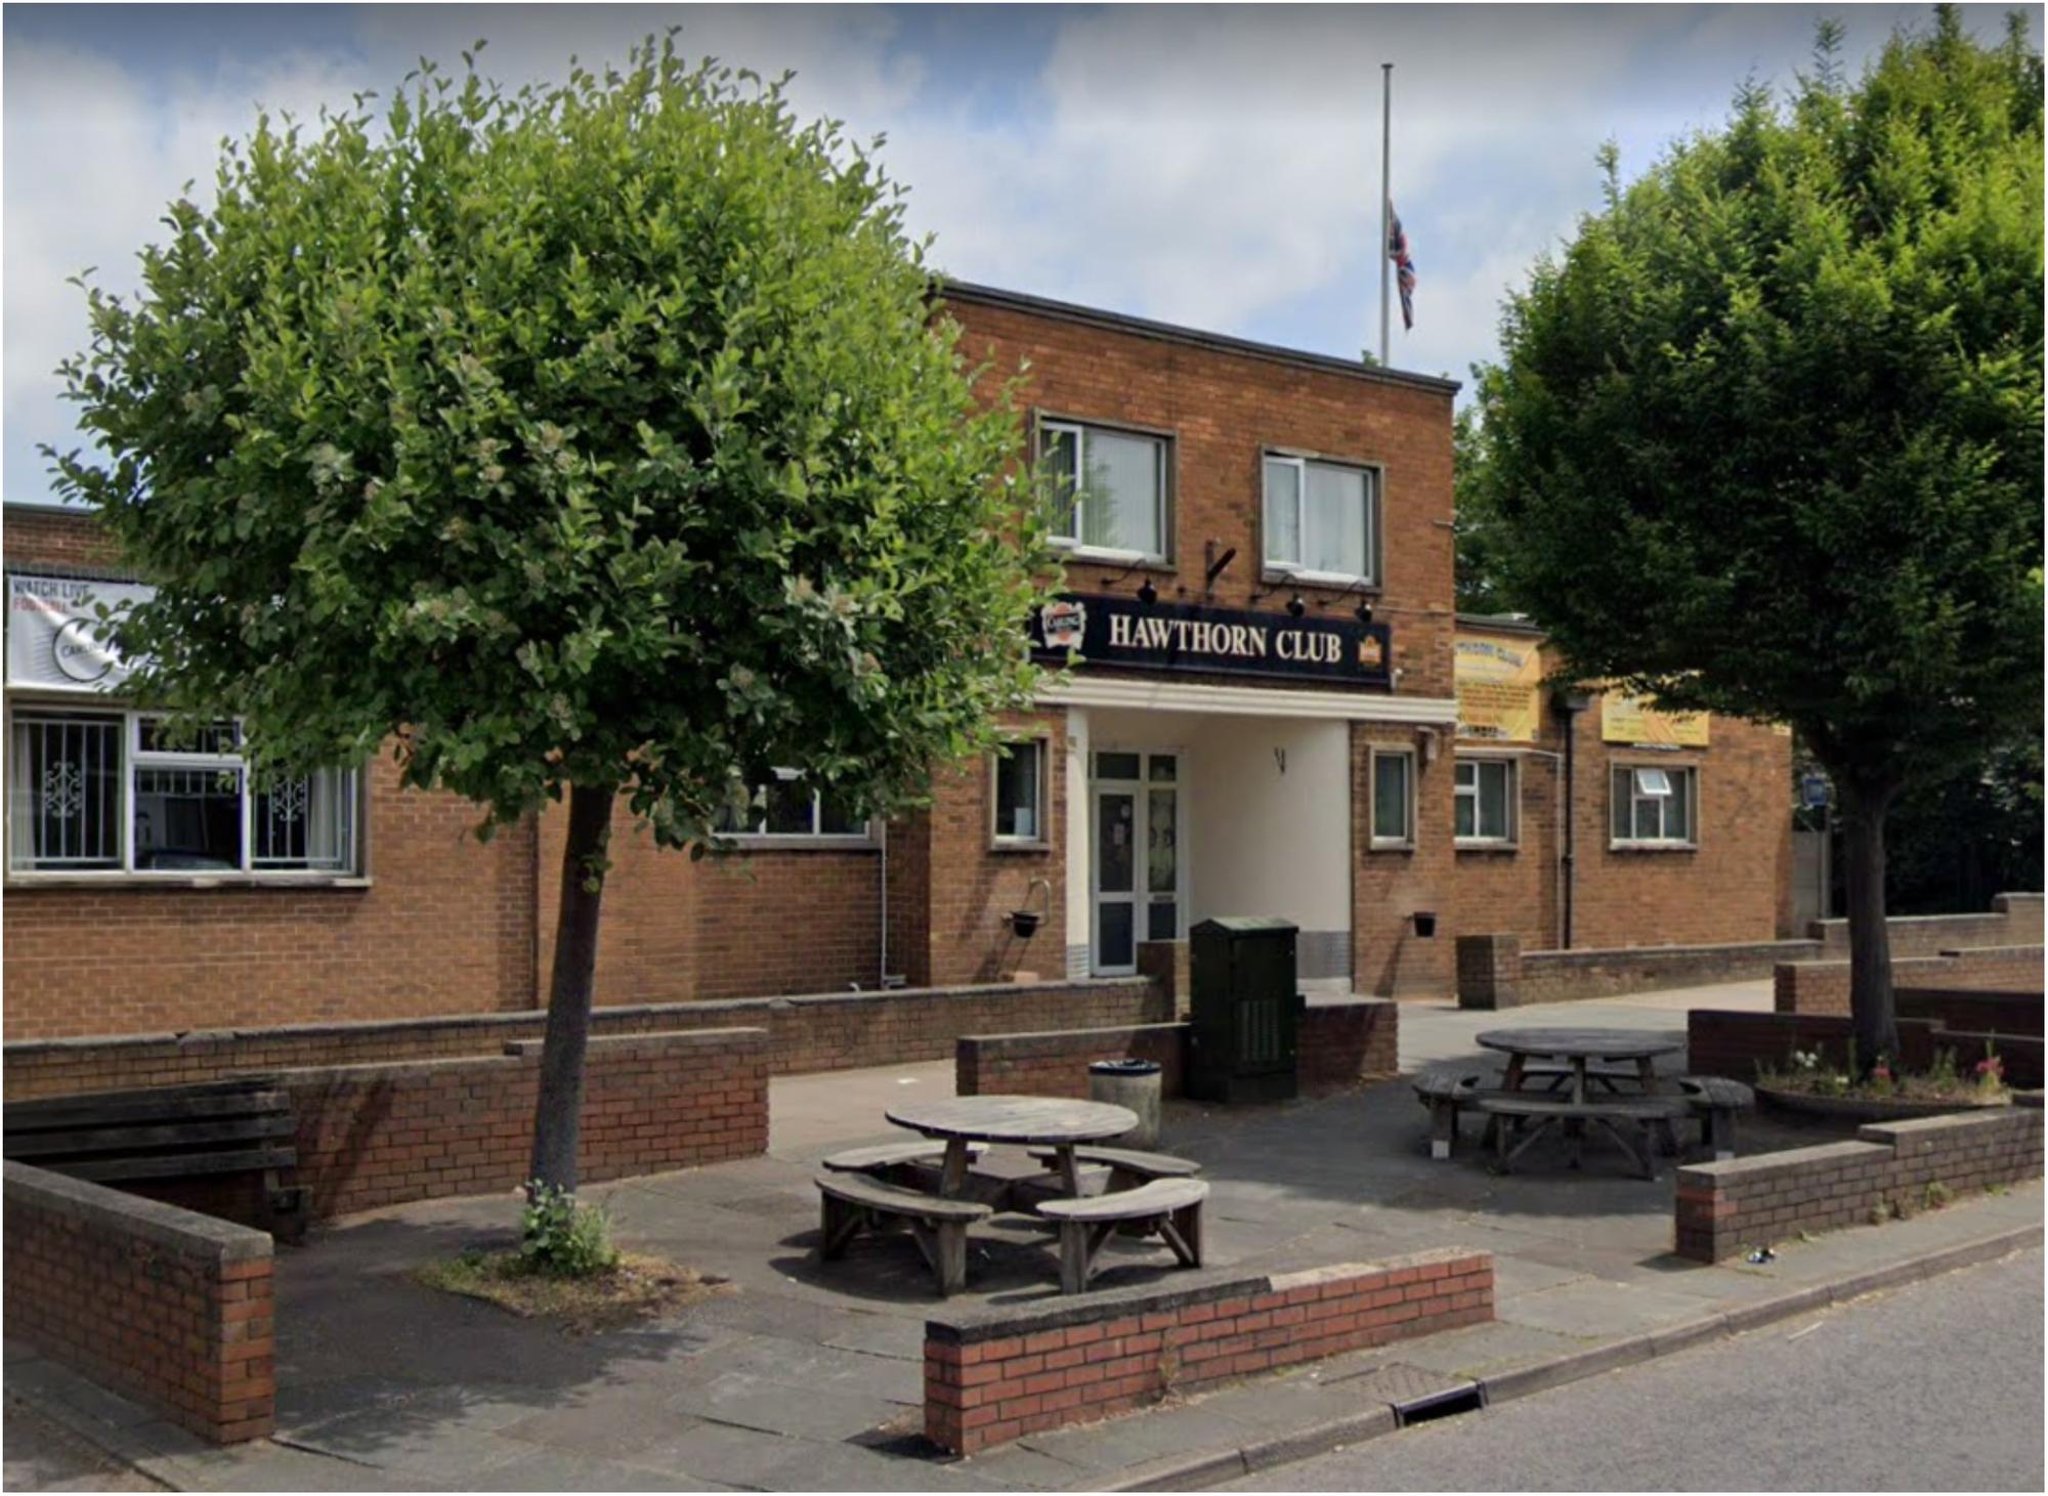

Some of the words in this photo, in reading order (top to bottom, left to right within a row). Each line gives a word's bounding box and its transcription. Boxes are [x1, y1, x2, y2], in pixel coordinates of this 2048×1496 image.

[13, 580, 58, 596] WATCH
[63, 583, 89, 598] LIVE
[1109, 613, 1268, 657] HAWTHORN
[1275, 630, 1342, 663] CLUB
